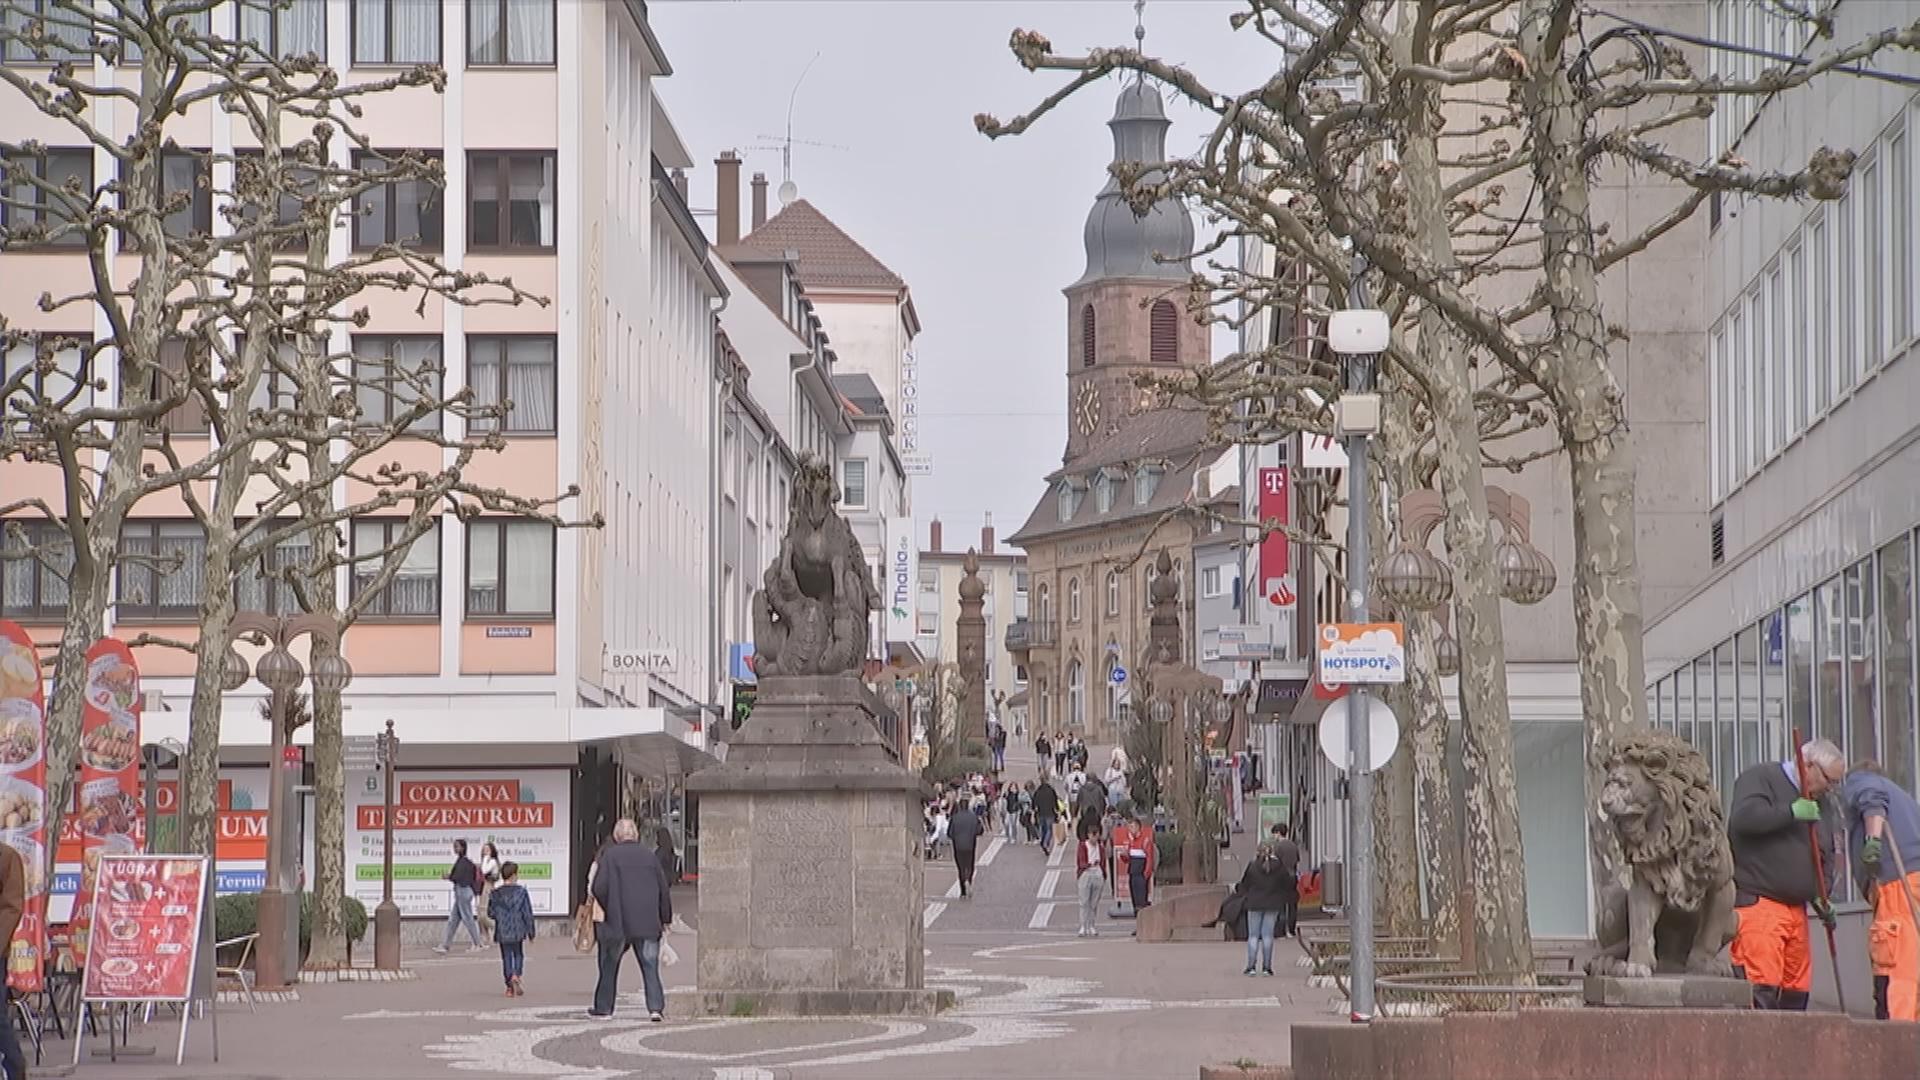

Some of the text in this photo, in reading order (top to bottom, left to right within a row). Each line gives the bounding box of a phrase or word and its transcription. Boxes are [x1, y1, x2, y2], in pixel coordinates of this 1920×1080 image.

[904, 351, 916, 450] STORCK
[1264, 471, 1284, 494] T
[612, 655, 671, 667] BONITA
[1323, 656, 1386, 669] HOTSPOT
[408, 783, 511, 802] CORONA
